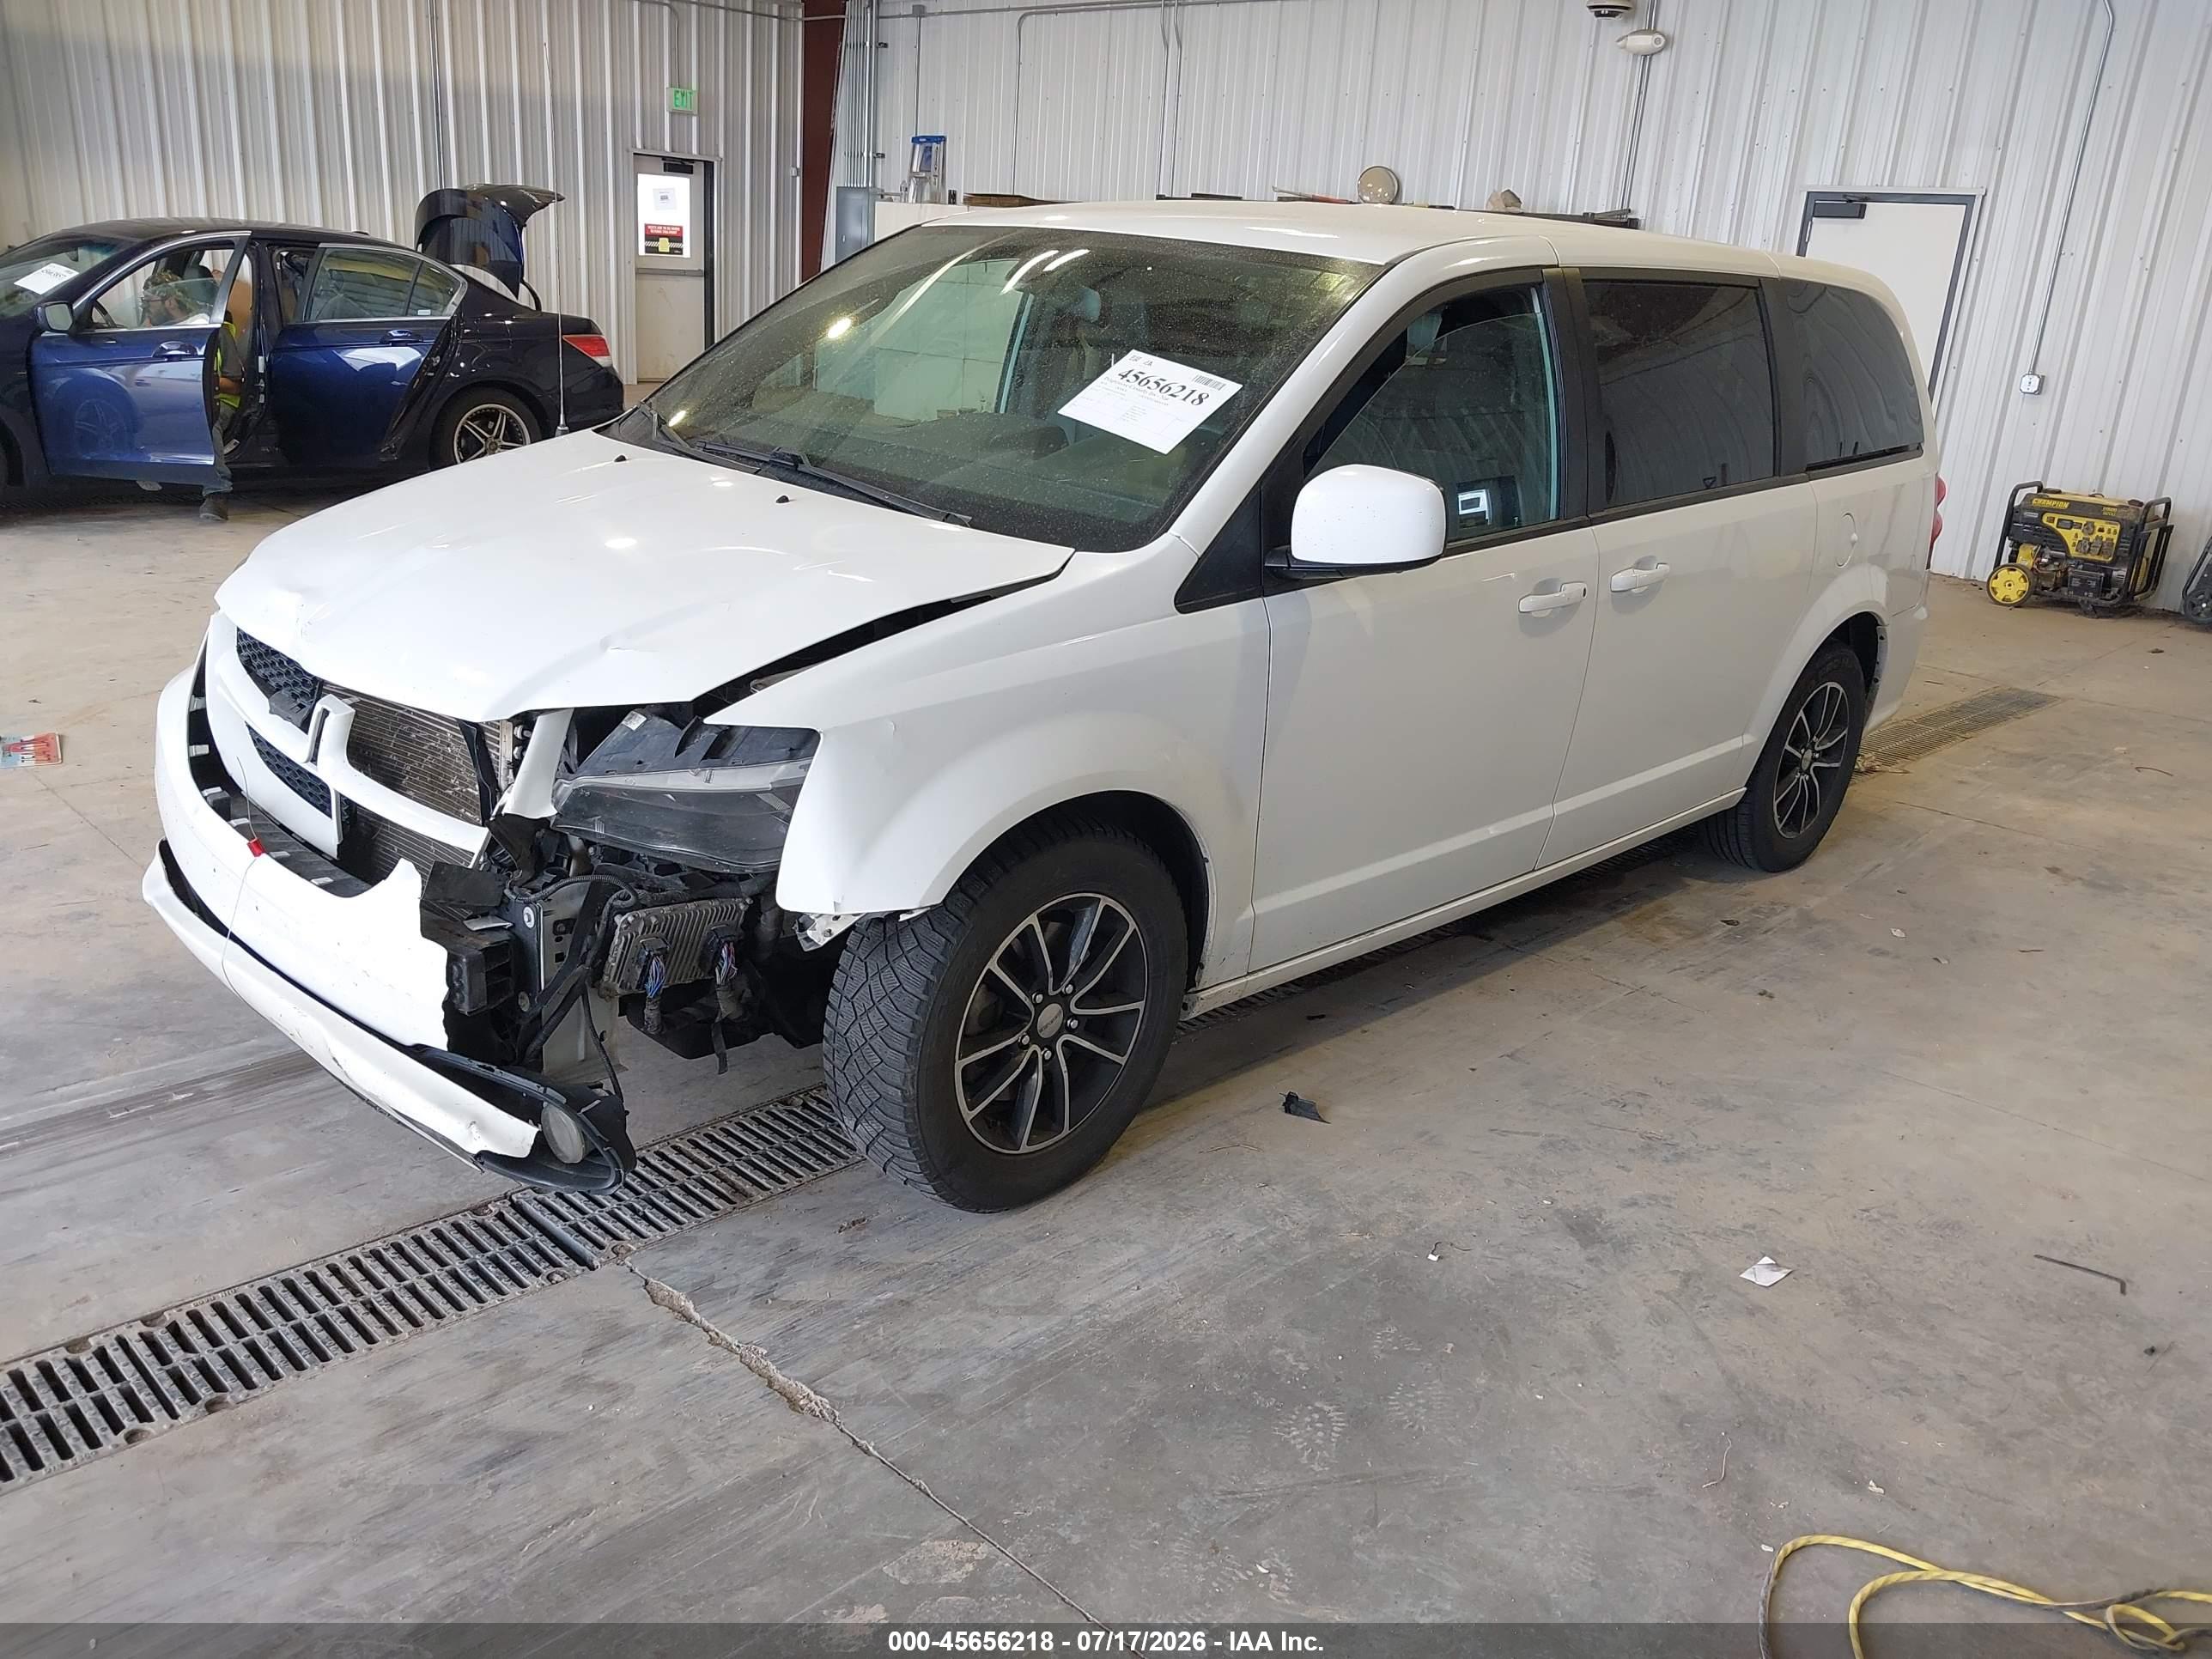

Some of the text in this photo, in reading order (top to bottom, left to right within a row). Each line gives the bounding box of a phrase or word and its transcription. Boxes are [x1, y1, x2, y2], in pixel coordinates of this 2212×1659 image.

[673, 89, 693, 110] EXIT
[1118, 368, 1210, 406] 45656218
[2032, 498, 2070, 509] CHAMPION
